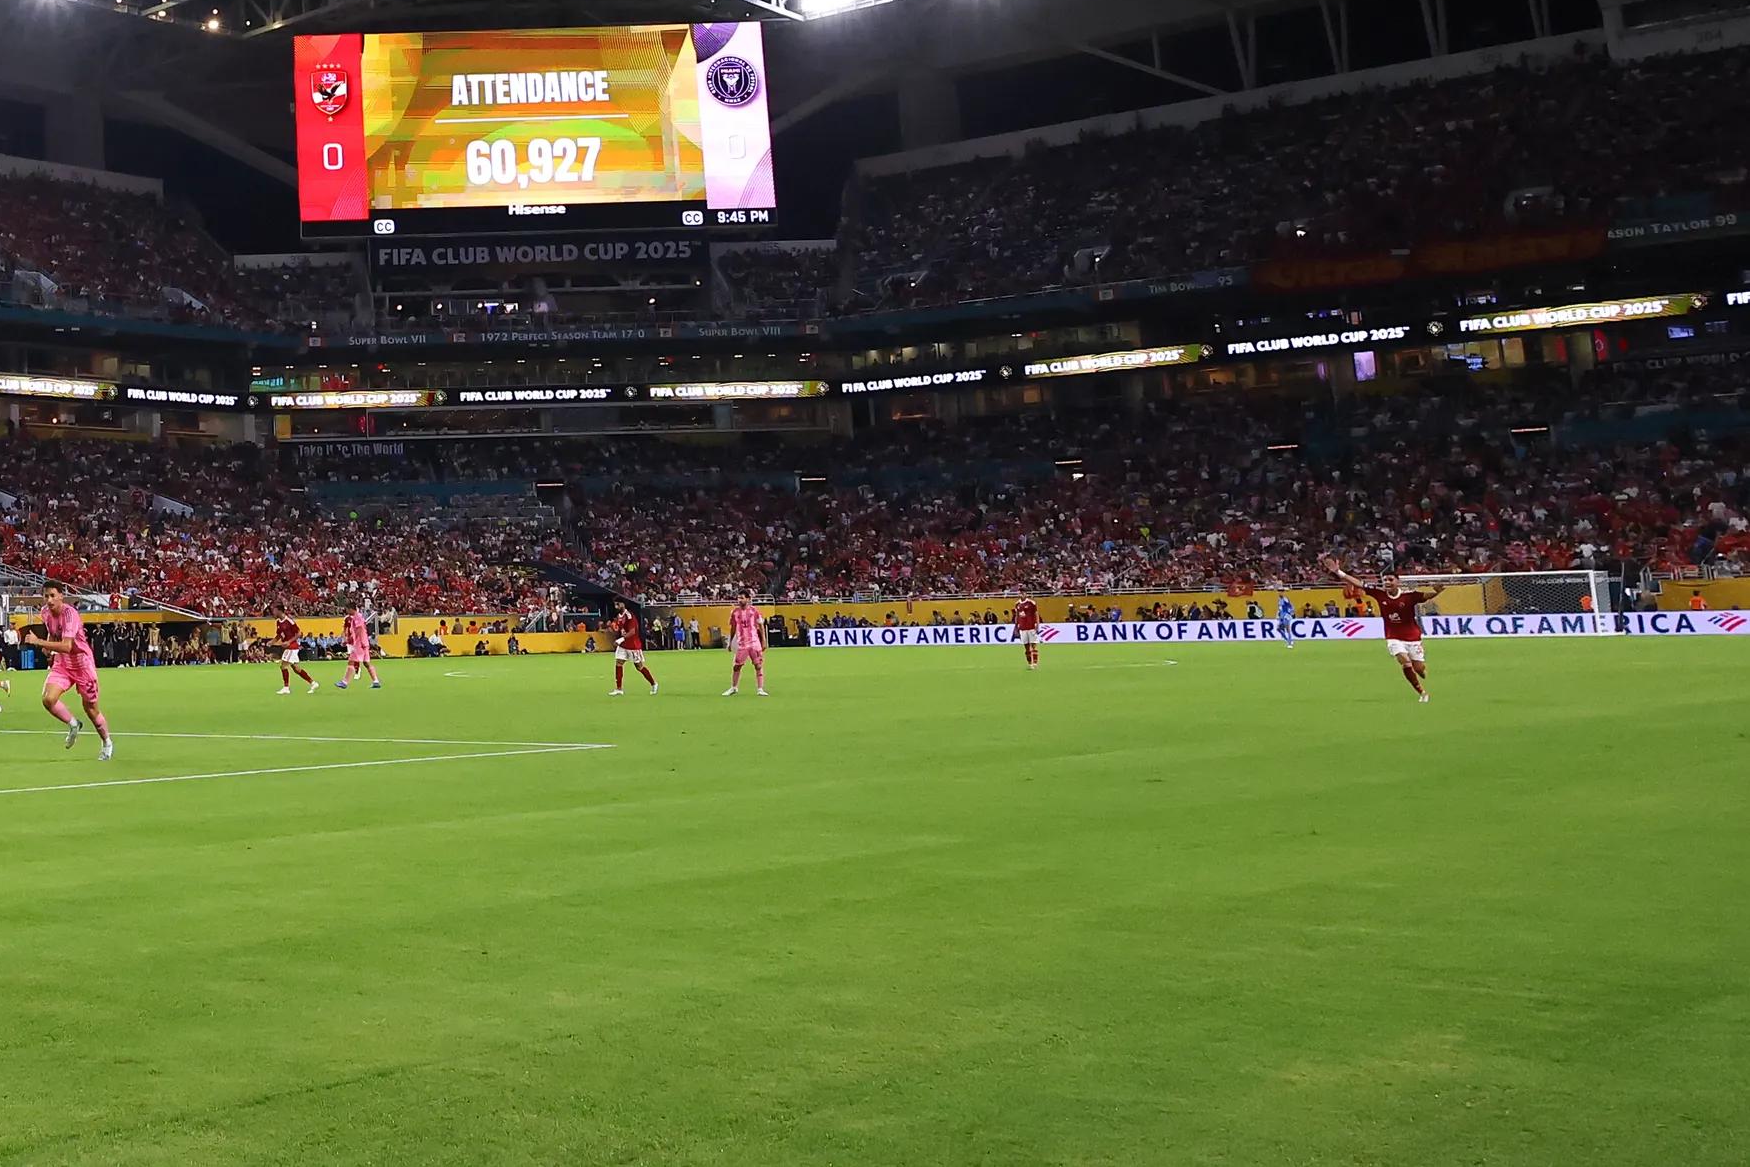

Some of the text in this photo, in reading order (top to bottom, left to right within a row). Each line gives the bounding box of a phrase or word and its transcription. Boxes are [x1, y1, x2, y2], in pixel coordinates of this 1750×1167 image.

[451, 71, 610, 106] ATTENDANCE
[322, 143, 343, 171] 0
[466, 136, 601, 190] 60,927
[508, 204, 566, 215] Hisense
[717, 210, 769, 223] 9:45 PM
[684, 213, 701, 224] CC
[376, 221, 393, 233] CC
[1607, 214, 1737, 239] ASON TAYLOR 99
[378, 247, 426, 267] FIFA
[432, 246, 489, 266] CLUB
[495, 244, 578, 265] WORLD
[584, 242, 628, 262] CUP
[1218, 275, 1234, 286] 95
[1726, 292, 1750, 305] FIF
[1460, 318, 1492, 332] FIFA
[1492, 313, 1531, 329] CLUB
[1531, 308, 1587, 326] WORLD
[1588, 305, 1621, 319] CUP
[481, 332, 508, 342] 1972
[762, 326, 781, 336] VIII
[410, 334, 426, 344] VII
[1227, 343, 1256, 355] FIFA
[1256, 338, 1290, 352] CLUB
[1290, 333, 1339, 349] WORLD
[1340, 330, 1368, 344] CUP
[1024, 364, 1049, 376] FIFA
[1049, 360, 1080, 373] CLUB
[1080, 356, 1119, 371] WORLD
[1123, 353, 1148, 365] CUP
[21, 380, 53, 393] WORLD
[54, 382, 72, 394] CUP
[842, 382, 867, 393] FIFA
[866, 379, 893, 392] CLUB
[893, 376, 932, 389] WORLD
[932, 373, 954, 384] CUP
[127, 388, 146, 400] FIFA
[146, 390, 167, 401] CLUB
[168, 391, 197, 403] WORLD
[198, 393, 214, 405] CUP
[459, 391, 484, 402] FIFA
[484, 390, 513, 401] CLUB
[514, 389, 554, 401] WORLD
[555, 389, 578, 400] CUP
[649, 387, 675, 398] FIFA
[675, 386, 704, 398] CLUB
[705, 385, 744, 397] WORLD
[745, 385, 769, 396] CUP
[271, 396, 295, 407] FIFA
[295, 395, 324, 406] CLUB
[325, 394, 365, 406] WORLD
[366, 394, 389, 405] CUP
[1076, 620, 1328, 641] BANK OF AMERCA
[1422, 615, 1475, 635] NK
[1486, 616, 1525, 635] OF
[814, 628, 875, 646] BANK
[881, 628, 909, 645] OF
